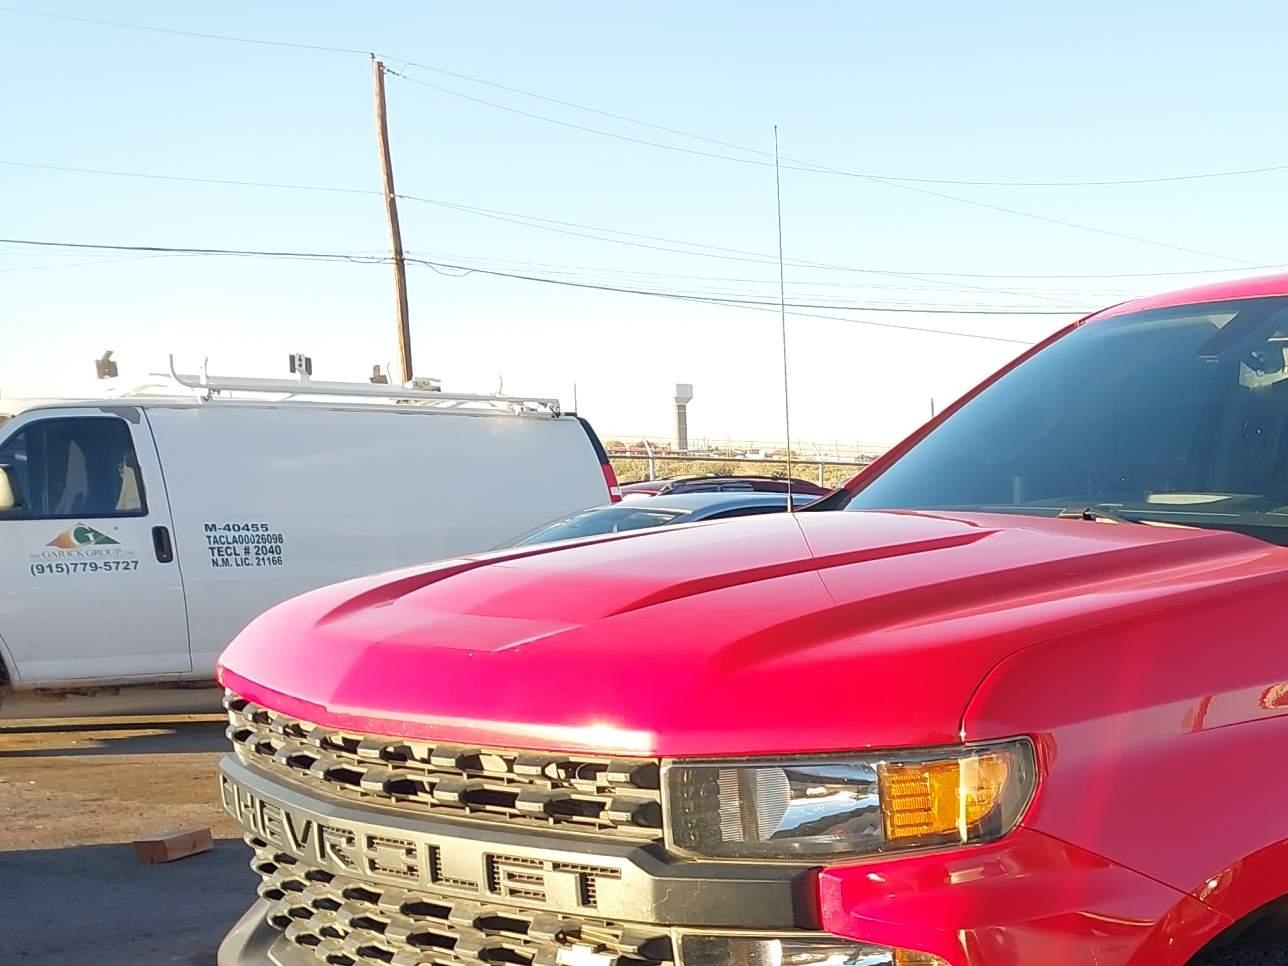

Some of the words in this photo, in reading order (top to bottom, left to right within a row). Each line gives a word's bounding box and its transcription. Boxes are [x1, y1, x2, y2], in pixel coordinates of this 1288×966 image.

[203, 523, 269, 532] M-40455
[206, 533, 284, 545] TACLA00026098
[208, 546, 241, 557] TECL
[243, 545, 251, 556] #
[254, 544, 282, 556] 2040
[211, 558, 233, 567] N.M.
[234, 557, 254, 567] LIC.
[255, 556, 283, 566] 21166
[30, 560, 139, 576] (915)779-5727
[220, 771, 622, 908] CHEVROLET
